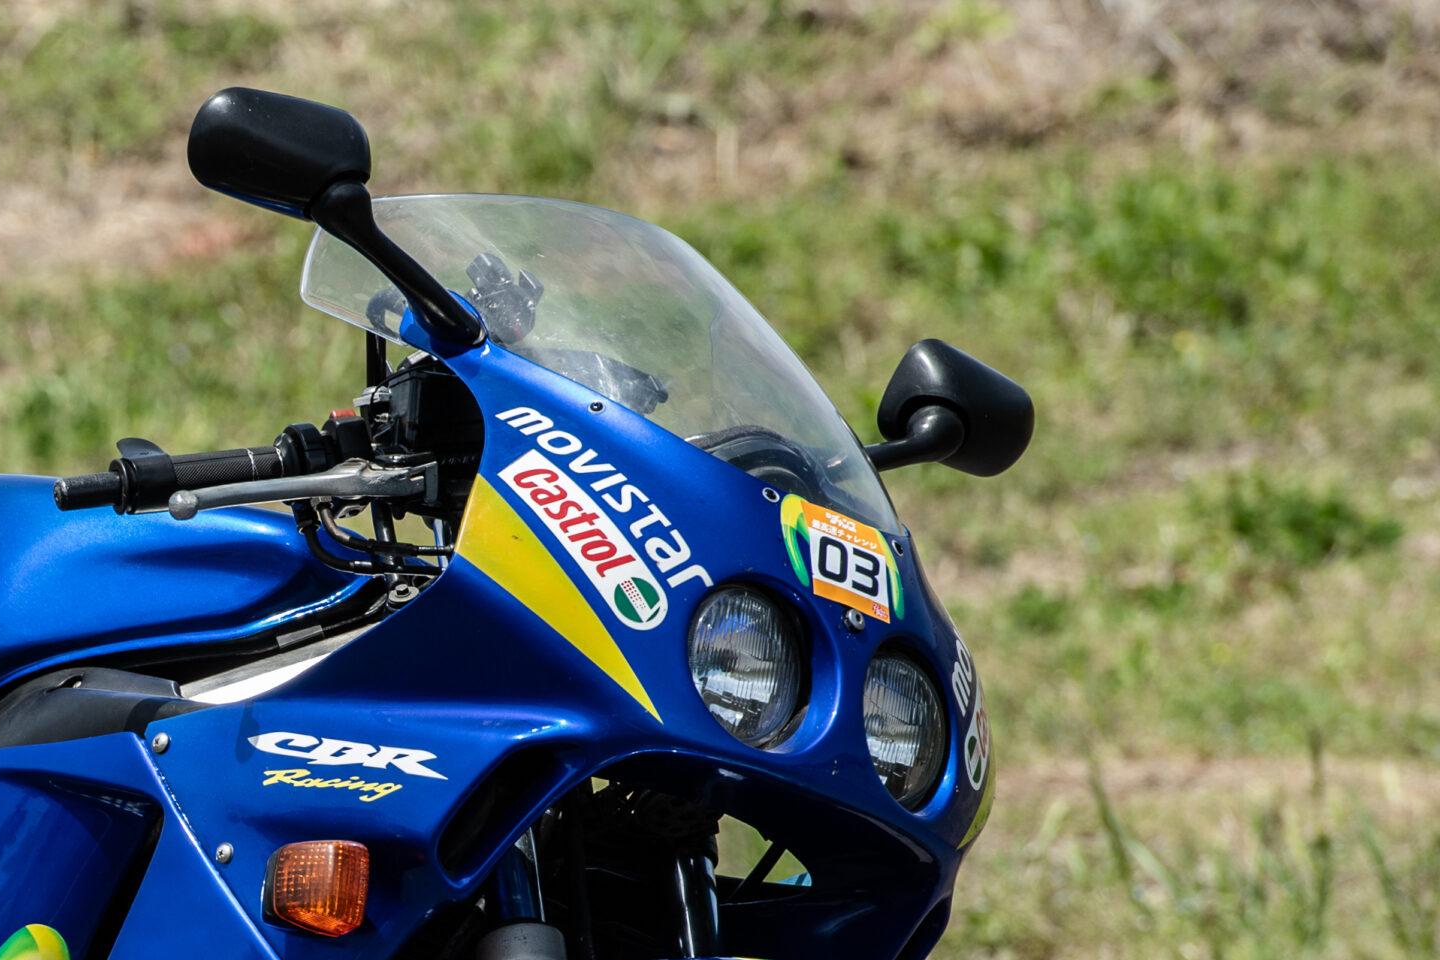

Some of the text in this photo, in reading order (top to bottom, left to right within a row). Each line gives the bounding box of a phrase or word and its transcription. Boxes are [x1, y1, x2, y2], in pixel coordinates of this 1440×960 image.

[512, 467, 636, 578] Castrol
[817, 535, 881, 597] 03
[247, 731, 449, 780] CBR
[262, 768, 403, 802] Racing
